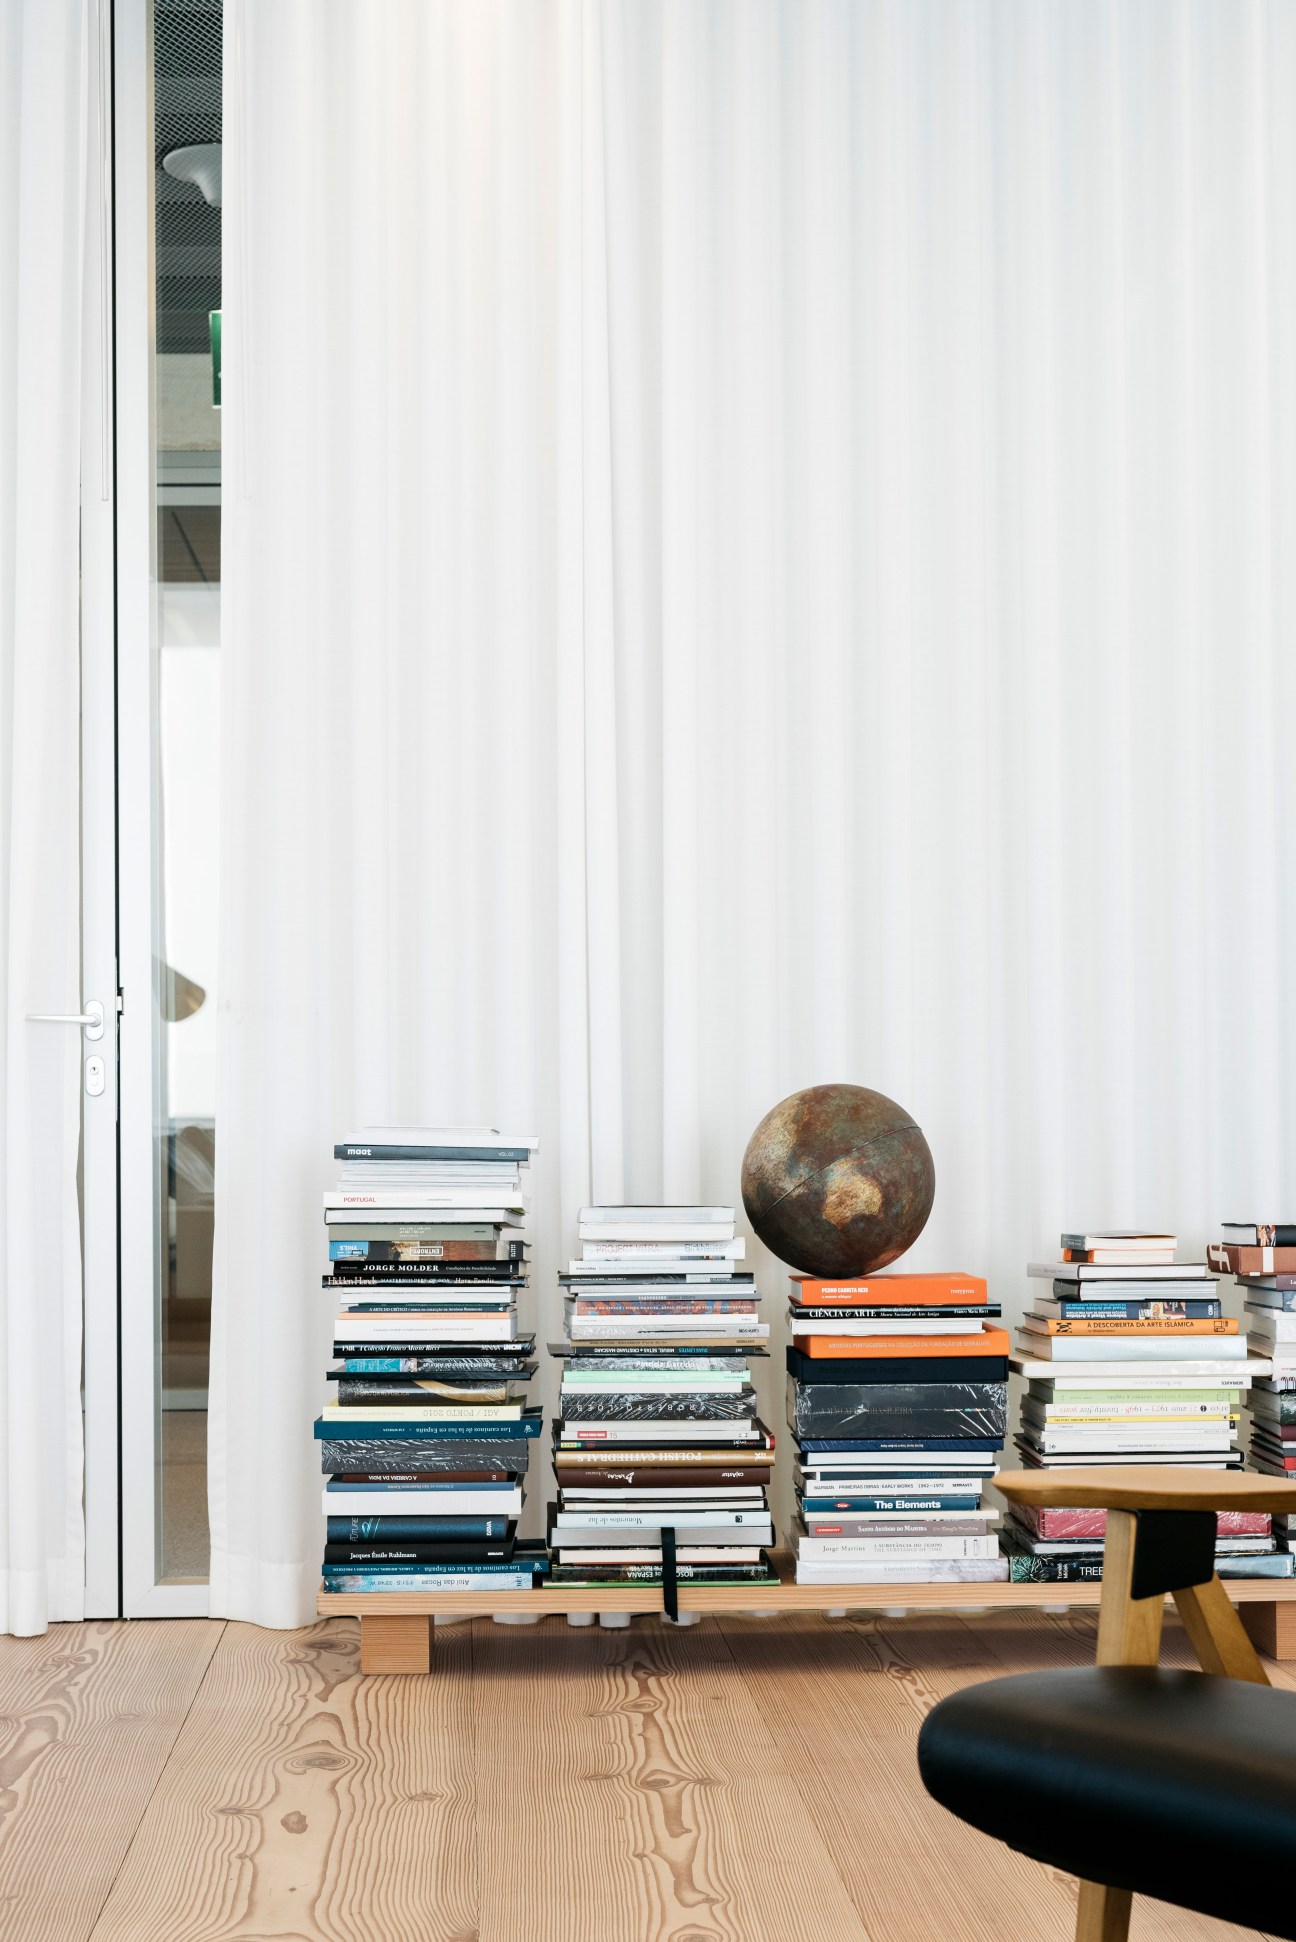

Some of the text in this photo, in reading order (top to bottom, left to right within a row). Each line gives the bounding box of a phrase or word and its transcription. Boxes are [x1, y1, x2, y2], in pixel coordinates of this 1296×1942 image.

[347, 1148, 372, 1156] maat
[398, 1264, 439, 1272] MOLDER
[809, 1307, 877, 1318] CIÊNCIA & ARTE
[416, 1426, 438, 1434] España
[576, 1452, 657, 1463] CATHEDRALS
[658, 1452, 702, 1462] POLISH
[874, 1500, 942, 1510] The Elements
[351, 1517, 359, 1542] FUTURE
[822, 1545, 839, 1553] Jorge
[350, 1552, 371, 1560] Jacques
[424, 1565, 446, 1573] España
[626, 1571, 653, 1579] ESPAÑA
